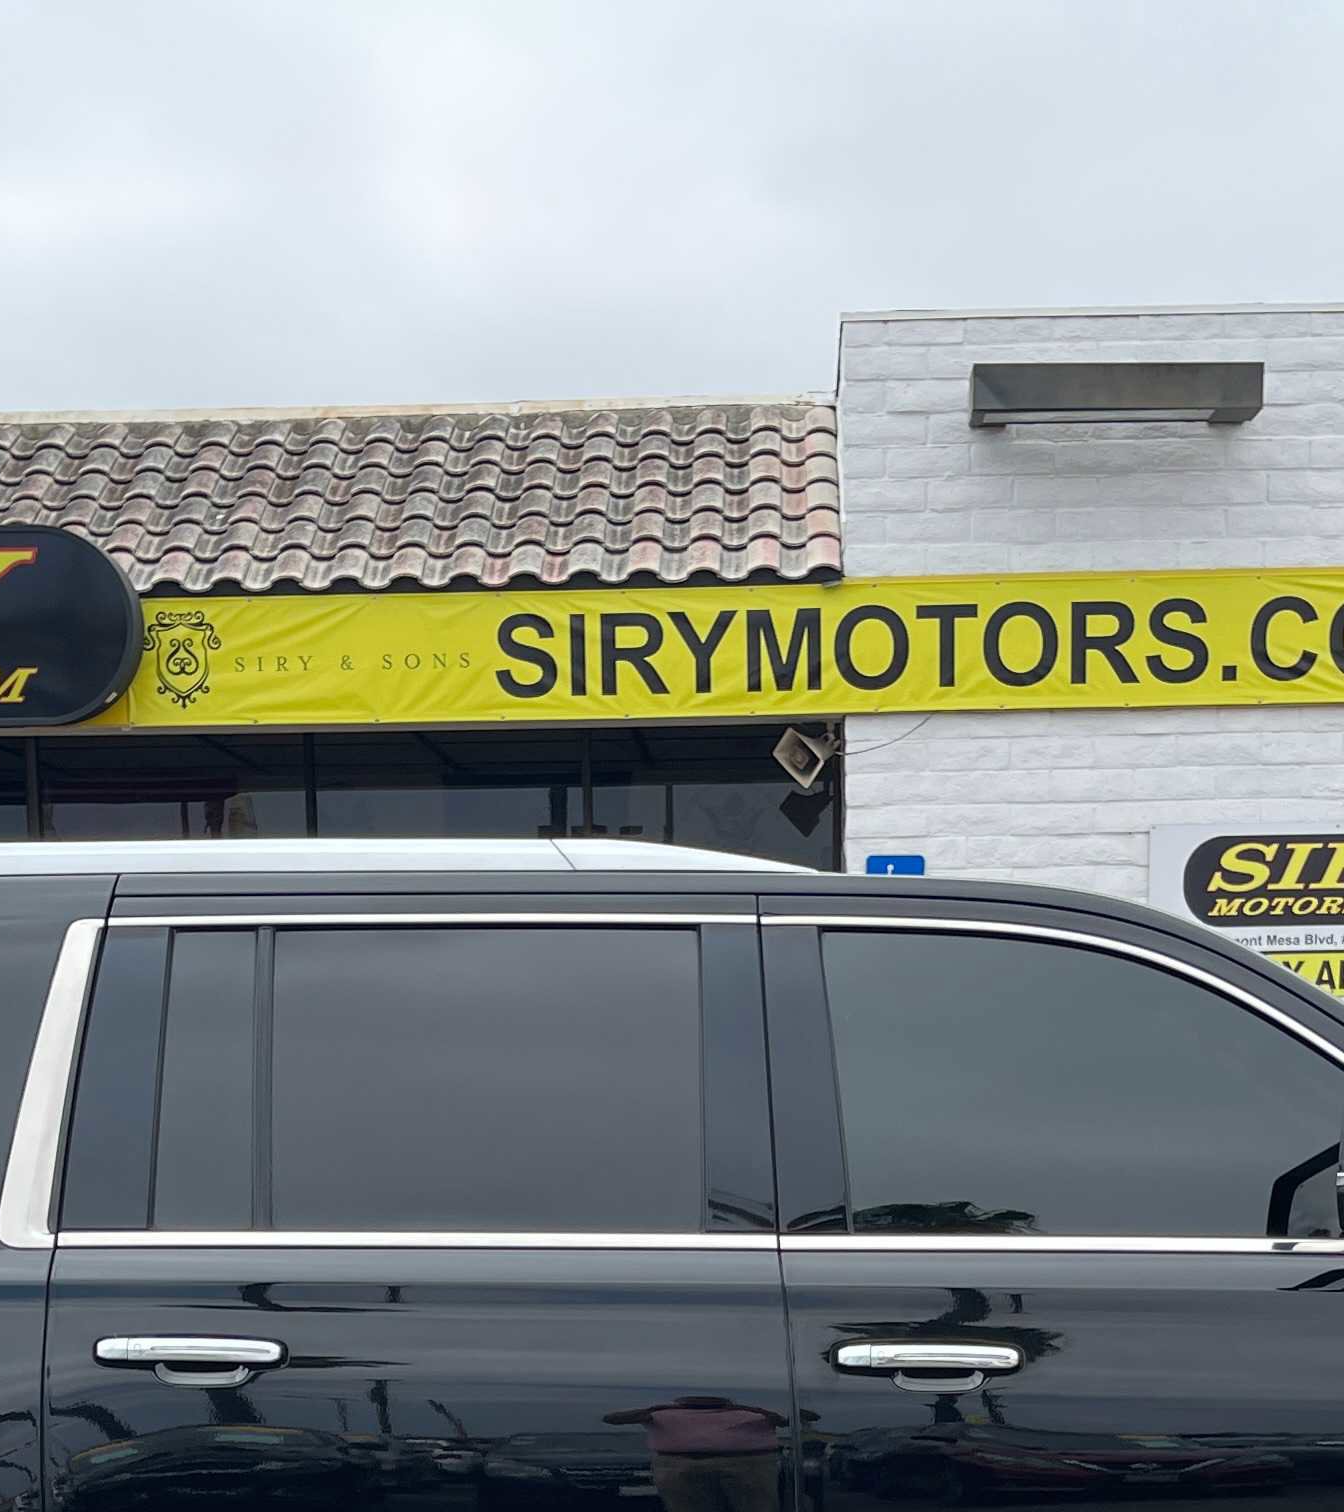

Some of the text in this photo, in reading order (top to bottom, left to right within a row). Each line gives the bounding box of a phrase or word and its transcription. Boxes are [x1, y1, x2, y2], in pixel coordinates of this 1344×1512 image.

[234, 652, 472, 673] SIRY & SONS
[1266, 934, 1300, 946] Mesa
[1305, 933, 1338, 946] Blvd,
